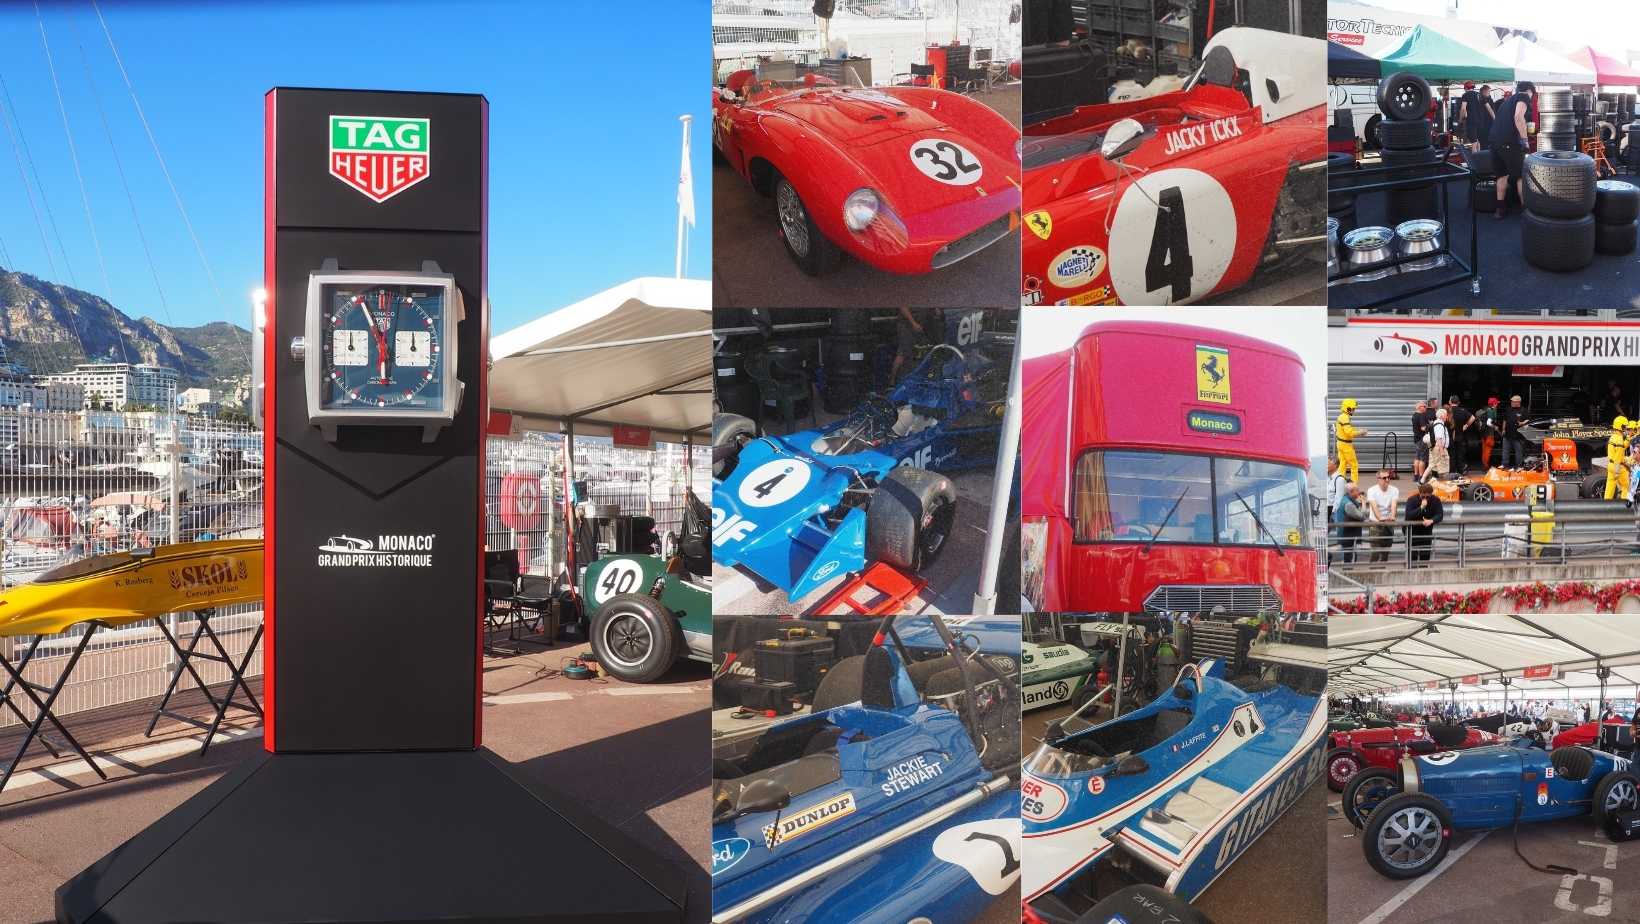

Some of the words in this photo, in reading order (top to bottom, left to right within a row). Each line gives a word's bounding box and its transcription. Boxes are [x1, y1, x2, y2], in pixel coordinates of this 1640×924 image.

[338, 121, 421, 149] TAG
[1165, 124, 1206, 155] JACKY
[1210, 115, 1243, 142] ICKX
[335, 155, 424, 195] HEUER
[914, 141, 981, 180] 32
[1145, 186, 1194, 303] 4
[957, 310, 984, 346] elf
[1444, 334, 1519, 356] MONACO
[1200, 390, 1229, 401] Ferrari
[1191, 416, 1233, 431] Monaco
[753, 473, 787, 499] 4
[378, 535, 433, 551] MONACO
[181, 560, 238, 586] SKOL
[602, 567, 636, 596] 40
[881, 761, 944, 797] STEWART
[887, 755, 928, 781] JACKIE
[783, 797, 851, 834] DUNLOP
[1214, 764, 1305, 871] GITANES
